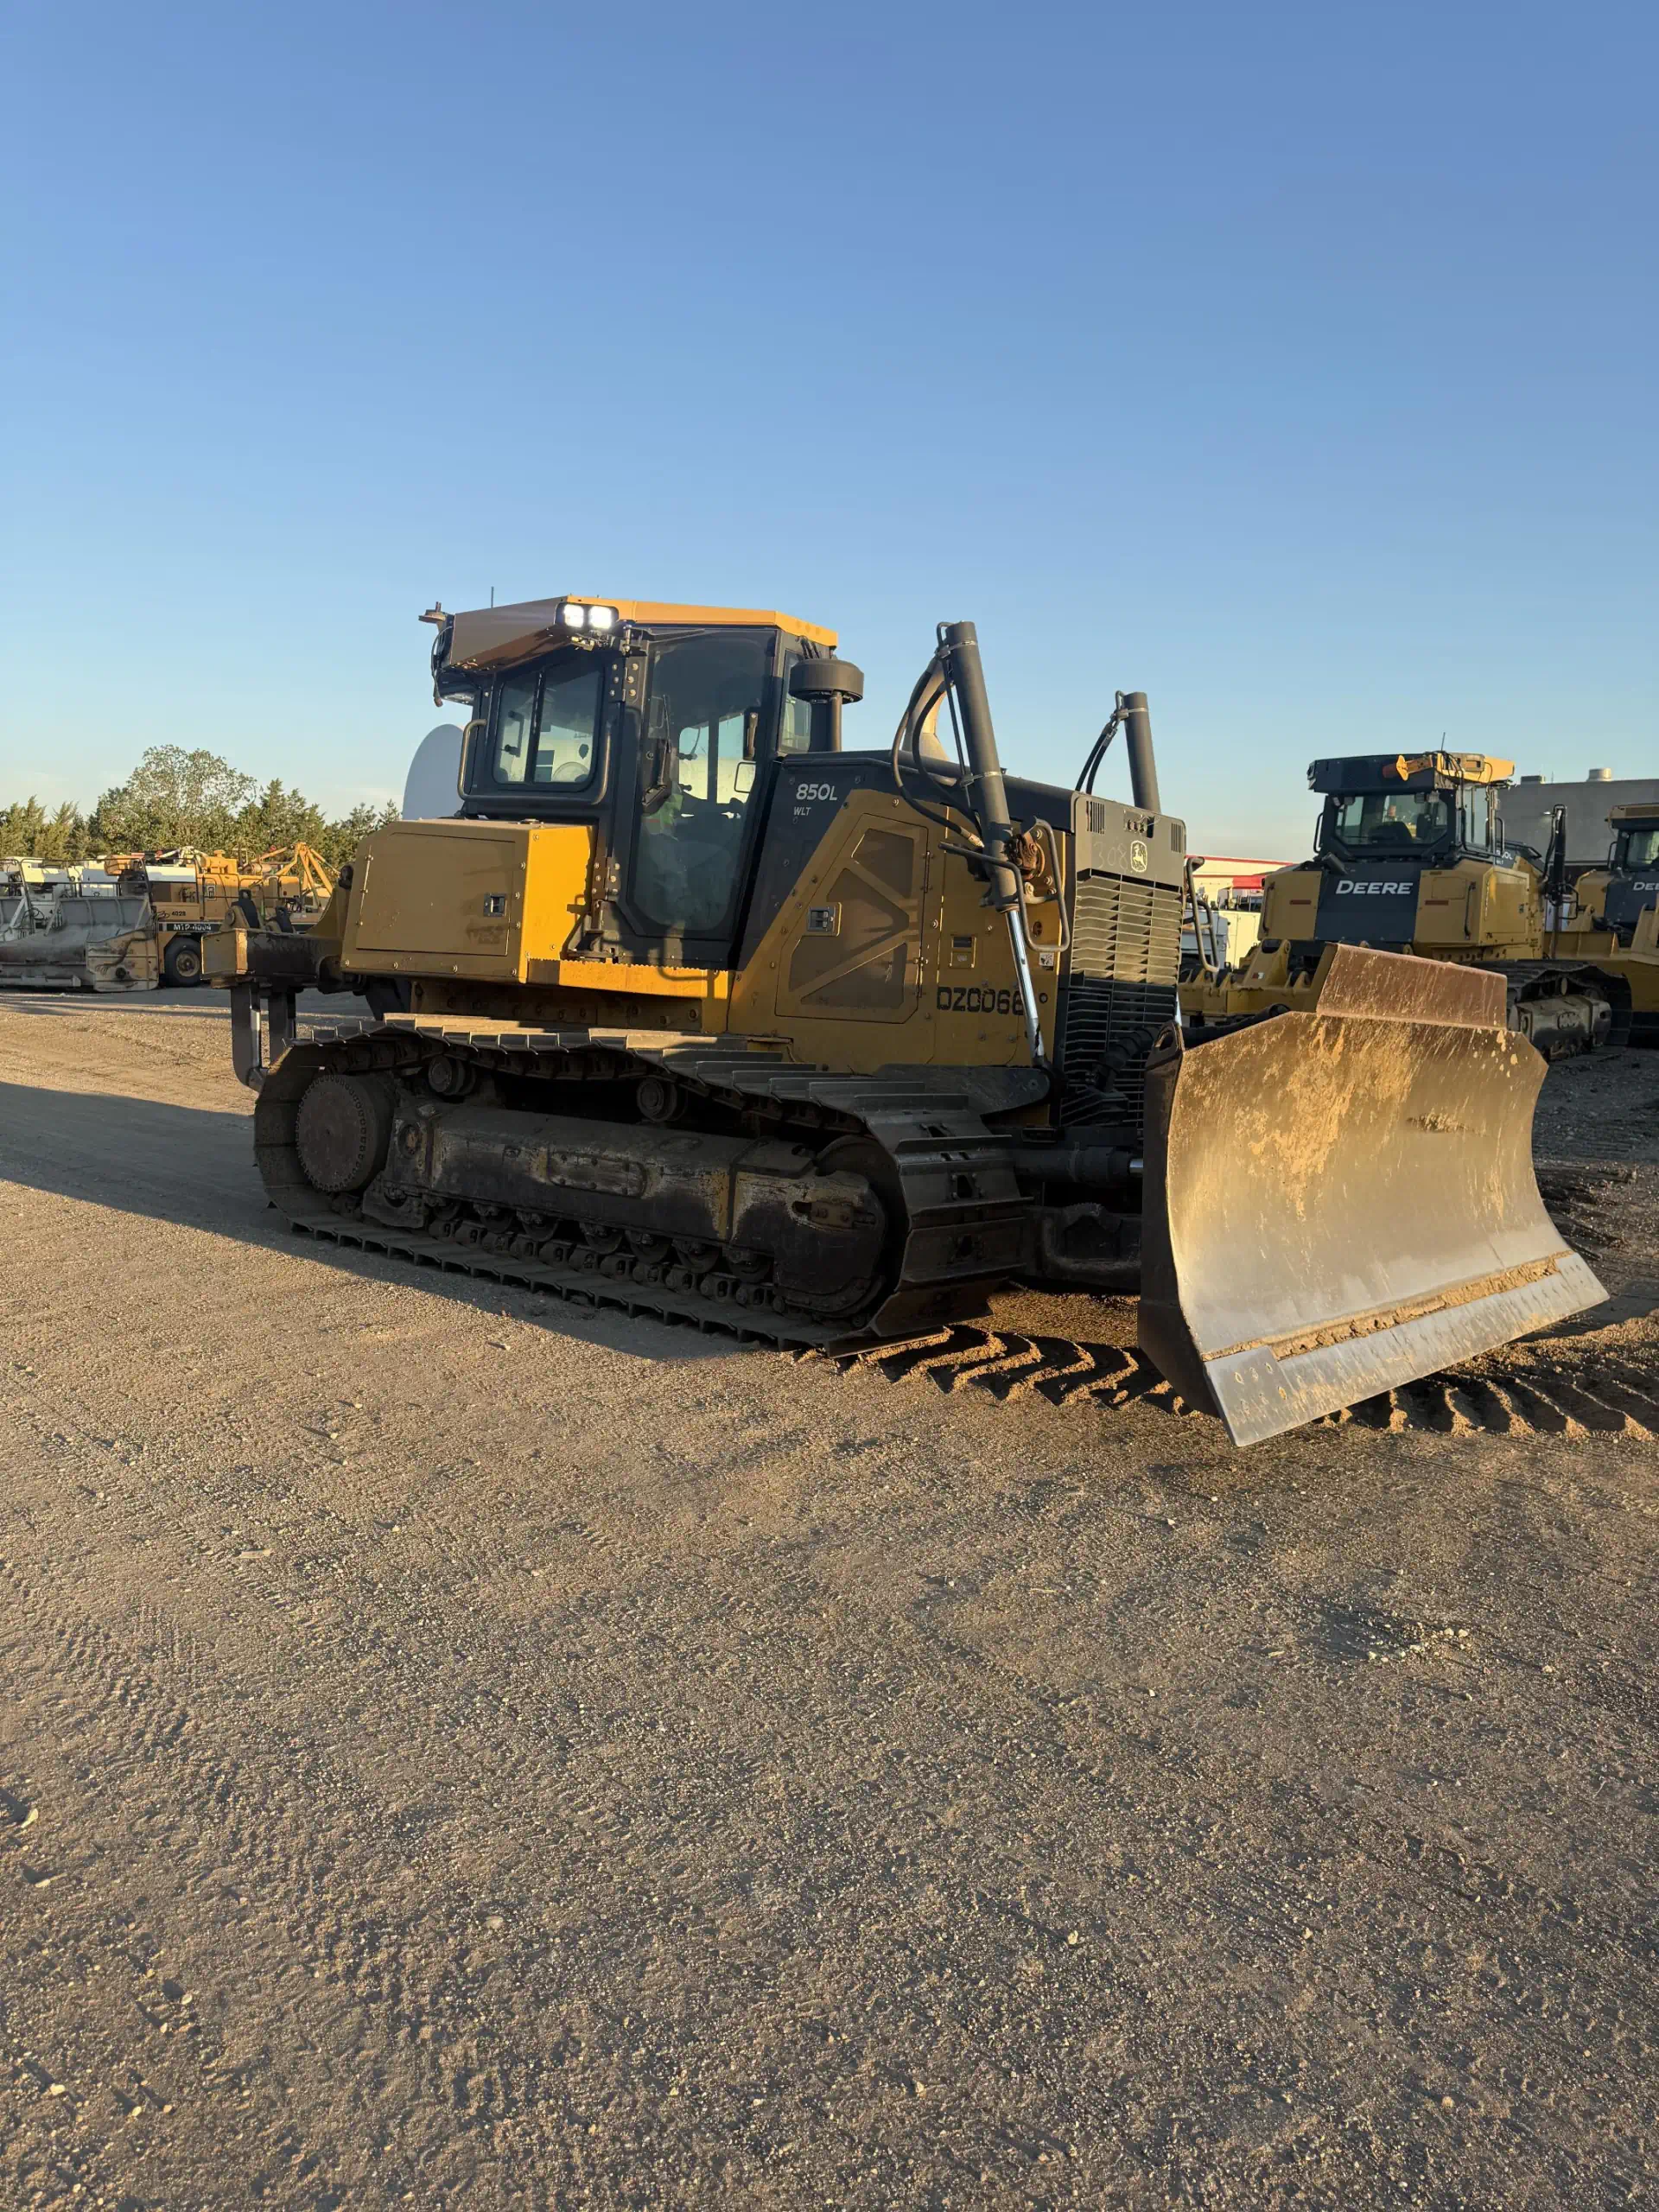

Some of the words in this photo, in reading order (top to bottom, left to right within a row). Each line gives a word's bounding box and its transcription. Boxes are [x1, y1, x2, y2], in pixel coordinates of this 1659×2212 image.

[796, 783, 838, 801] 850L
[793, 806, 812, 816] WLT
[1335, 880, 1414, 894] DEERE
